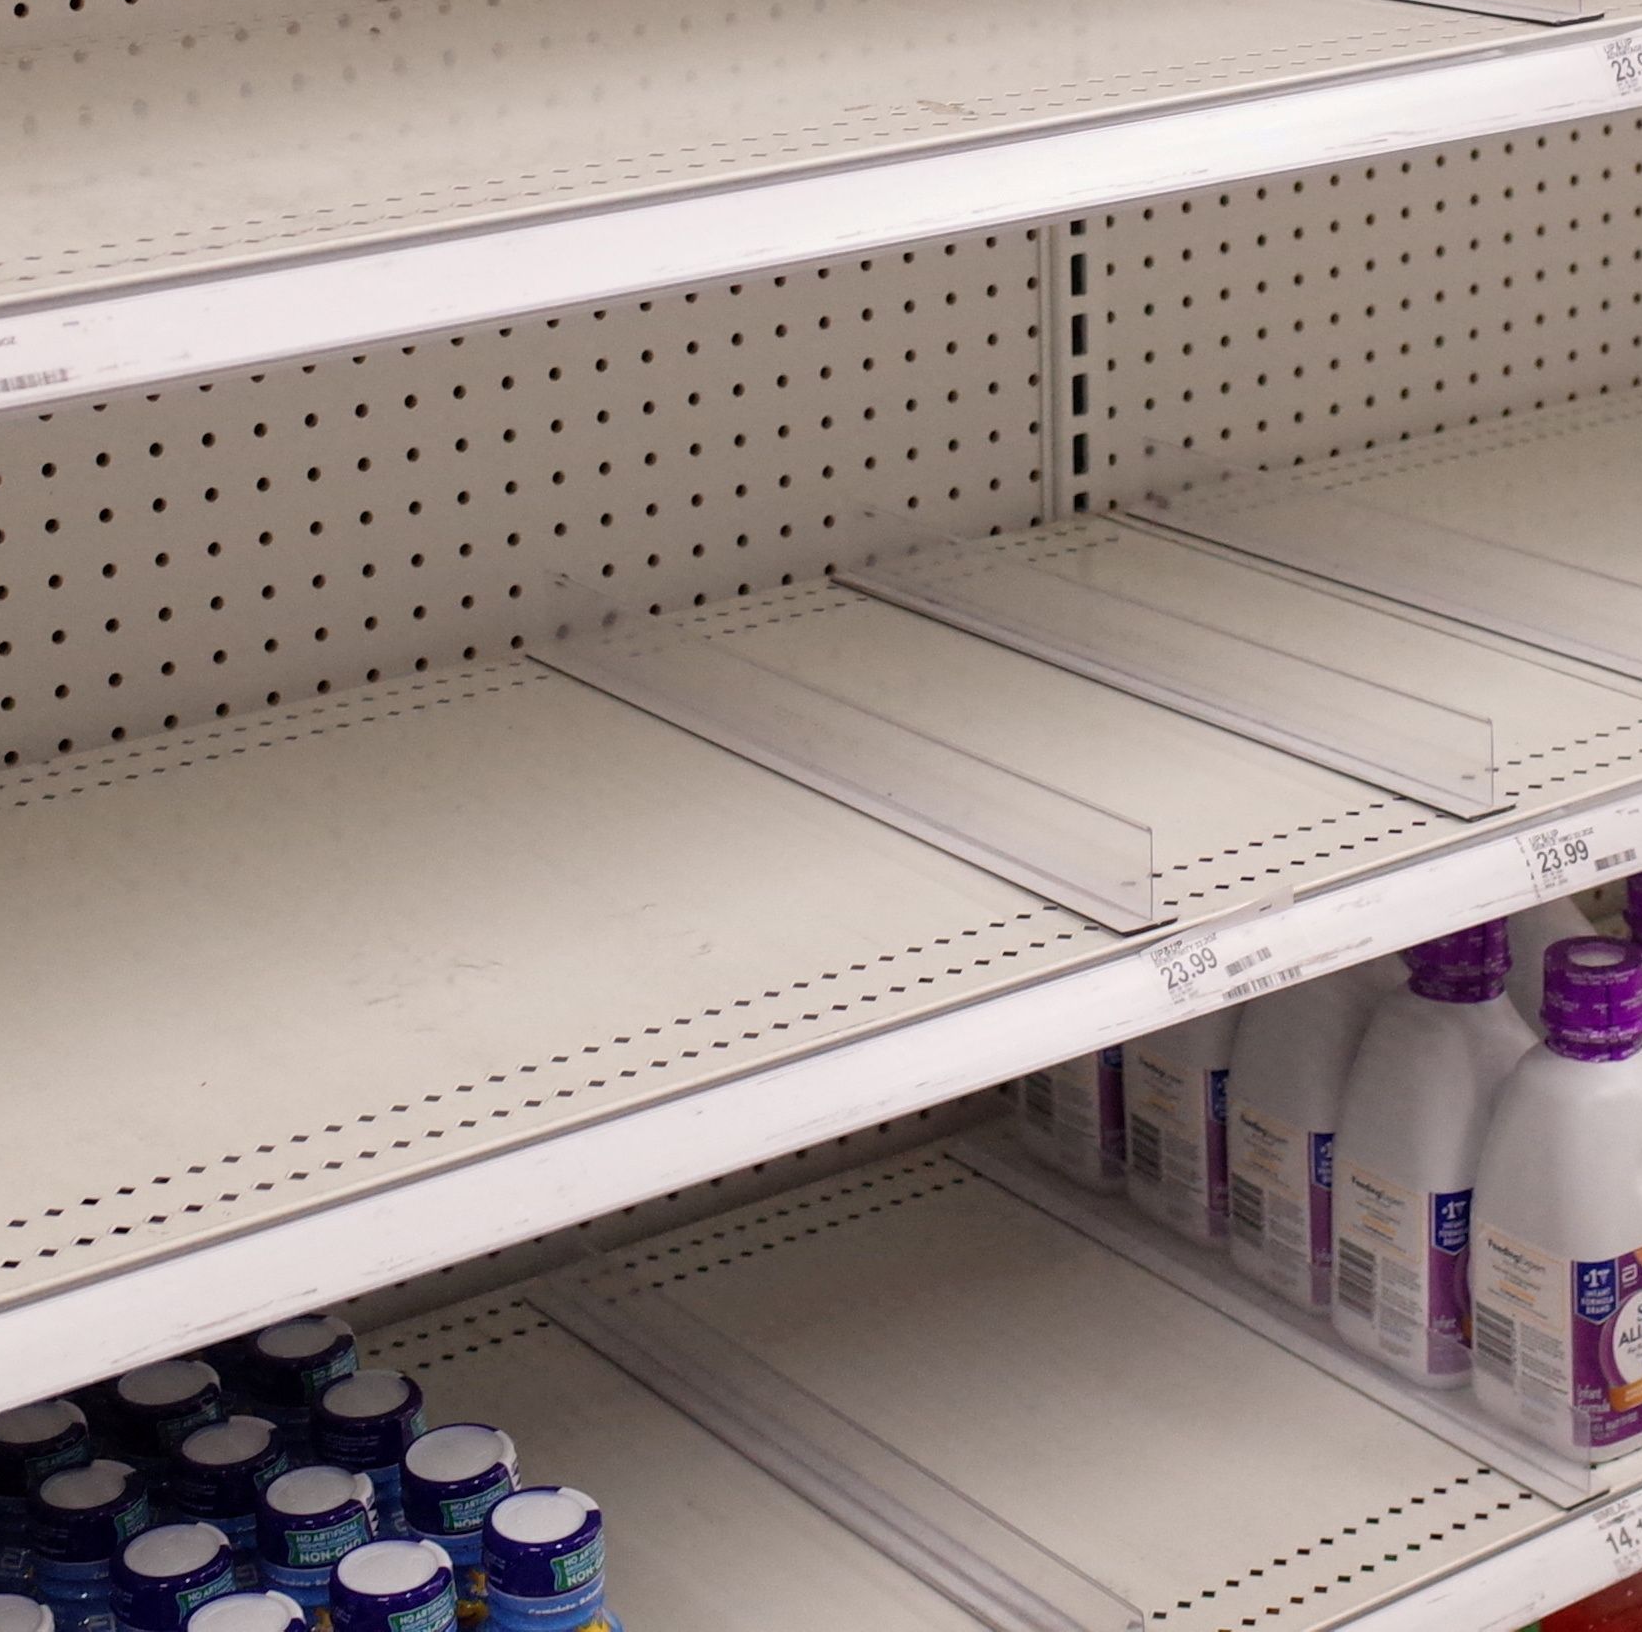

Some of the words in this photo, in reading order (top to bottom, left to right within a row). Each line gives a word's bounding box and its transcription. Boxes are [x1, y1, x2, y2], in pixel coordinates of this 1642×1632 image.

[1536, 839, 1589, 874] 23.99
[1150, 939, 1184, 962] UP&UP
[1159, 946, 1219, 990] 23.99
[450, 1501, 464, 1513] NO
[464, 1483, 510, 1508] ARTIFICIAL
[296, 1531, 310, 1543] NO
[311, 1521, 358, 1541] ARTIFICIAL
[298, 1539, 362, 1565] NON-GMO
[563, 1555, 577, 1567] NO
